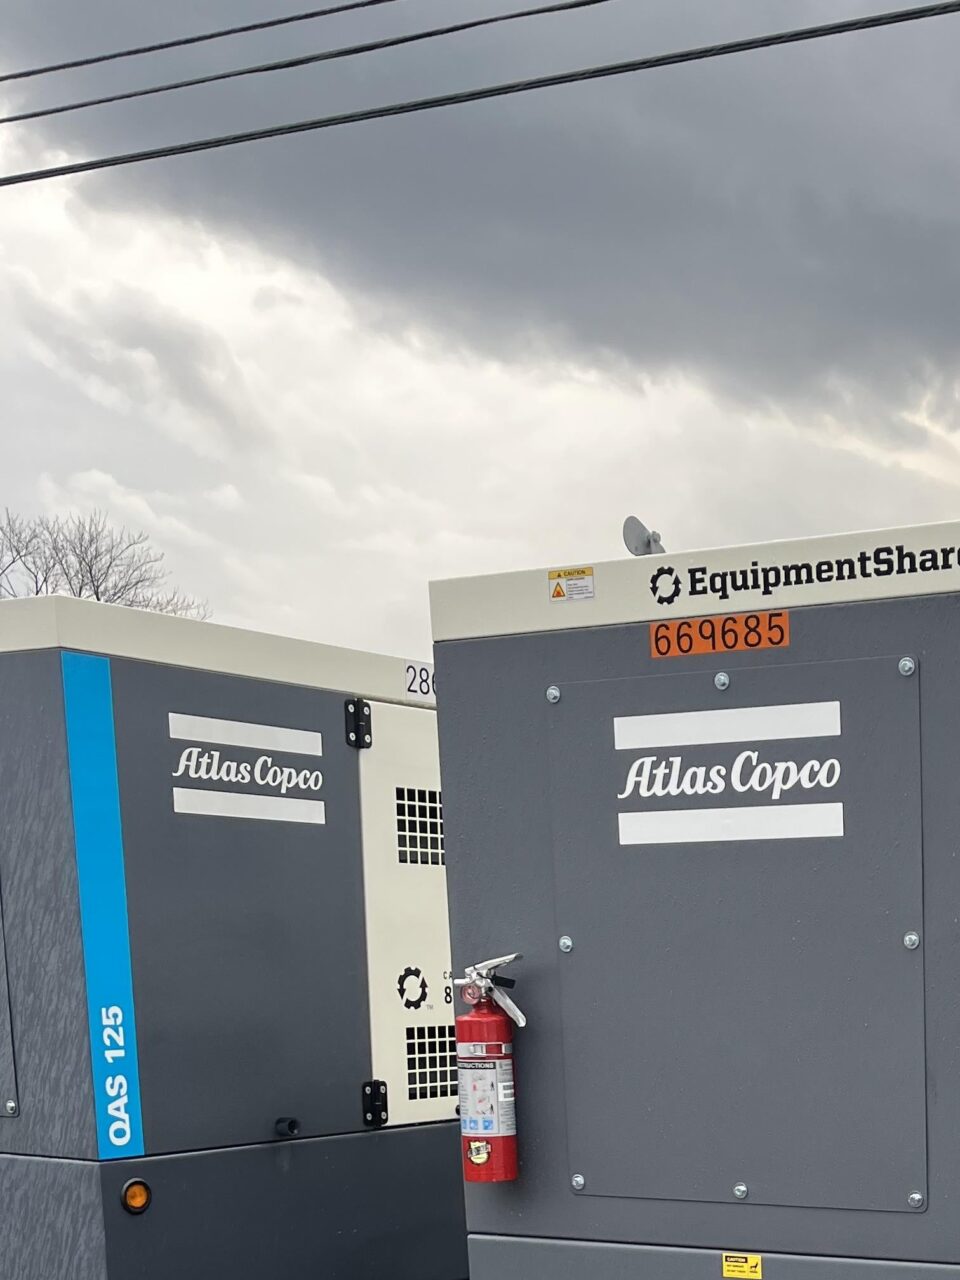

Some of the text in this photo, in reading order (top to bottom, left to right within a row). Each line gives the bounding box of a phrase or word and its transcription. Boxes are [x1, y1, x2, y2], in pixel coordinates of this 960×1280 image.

[563, 569, 586, 577] CAUTION
[653, 612, 786, 656] 669685
[172, 747, 323, 794] Atlas Copco
[617, 750, 841, 800] Atlas Copco
[101, 1005, 131, 1146] QAS 125
